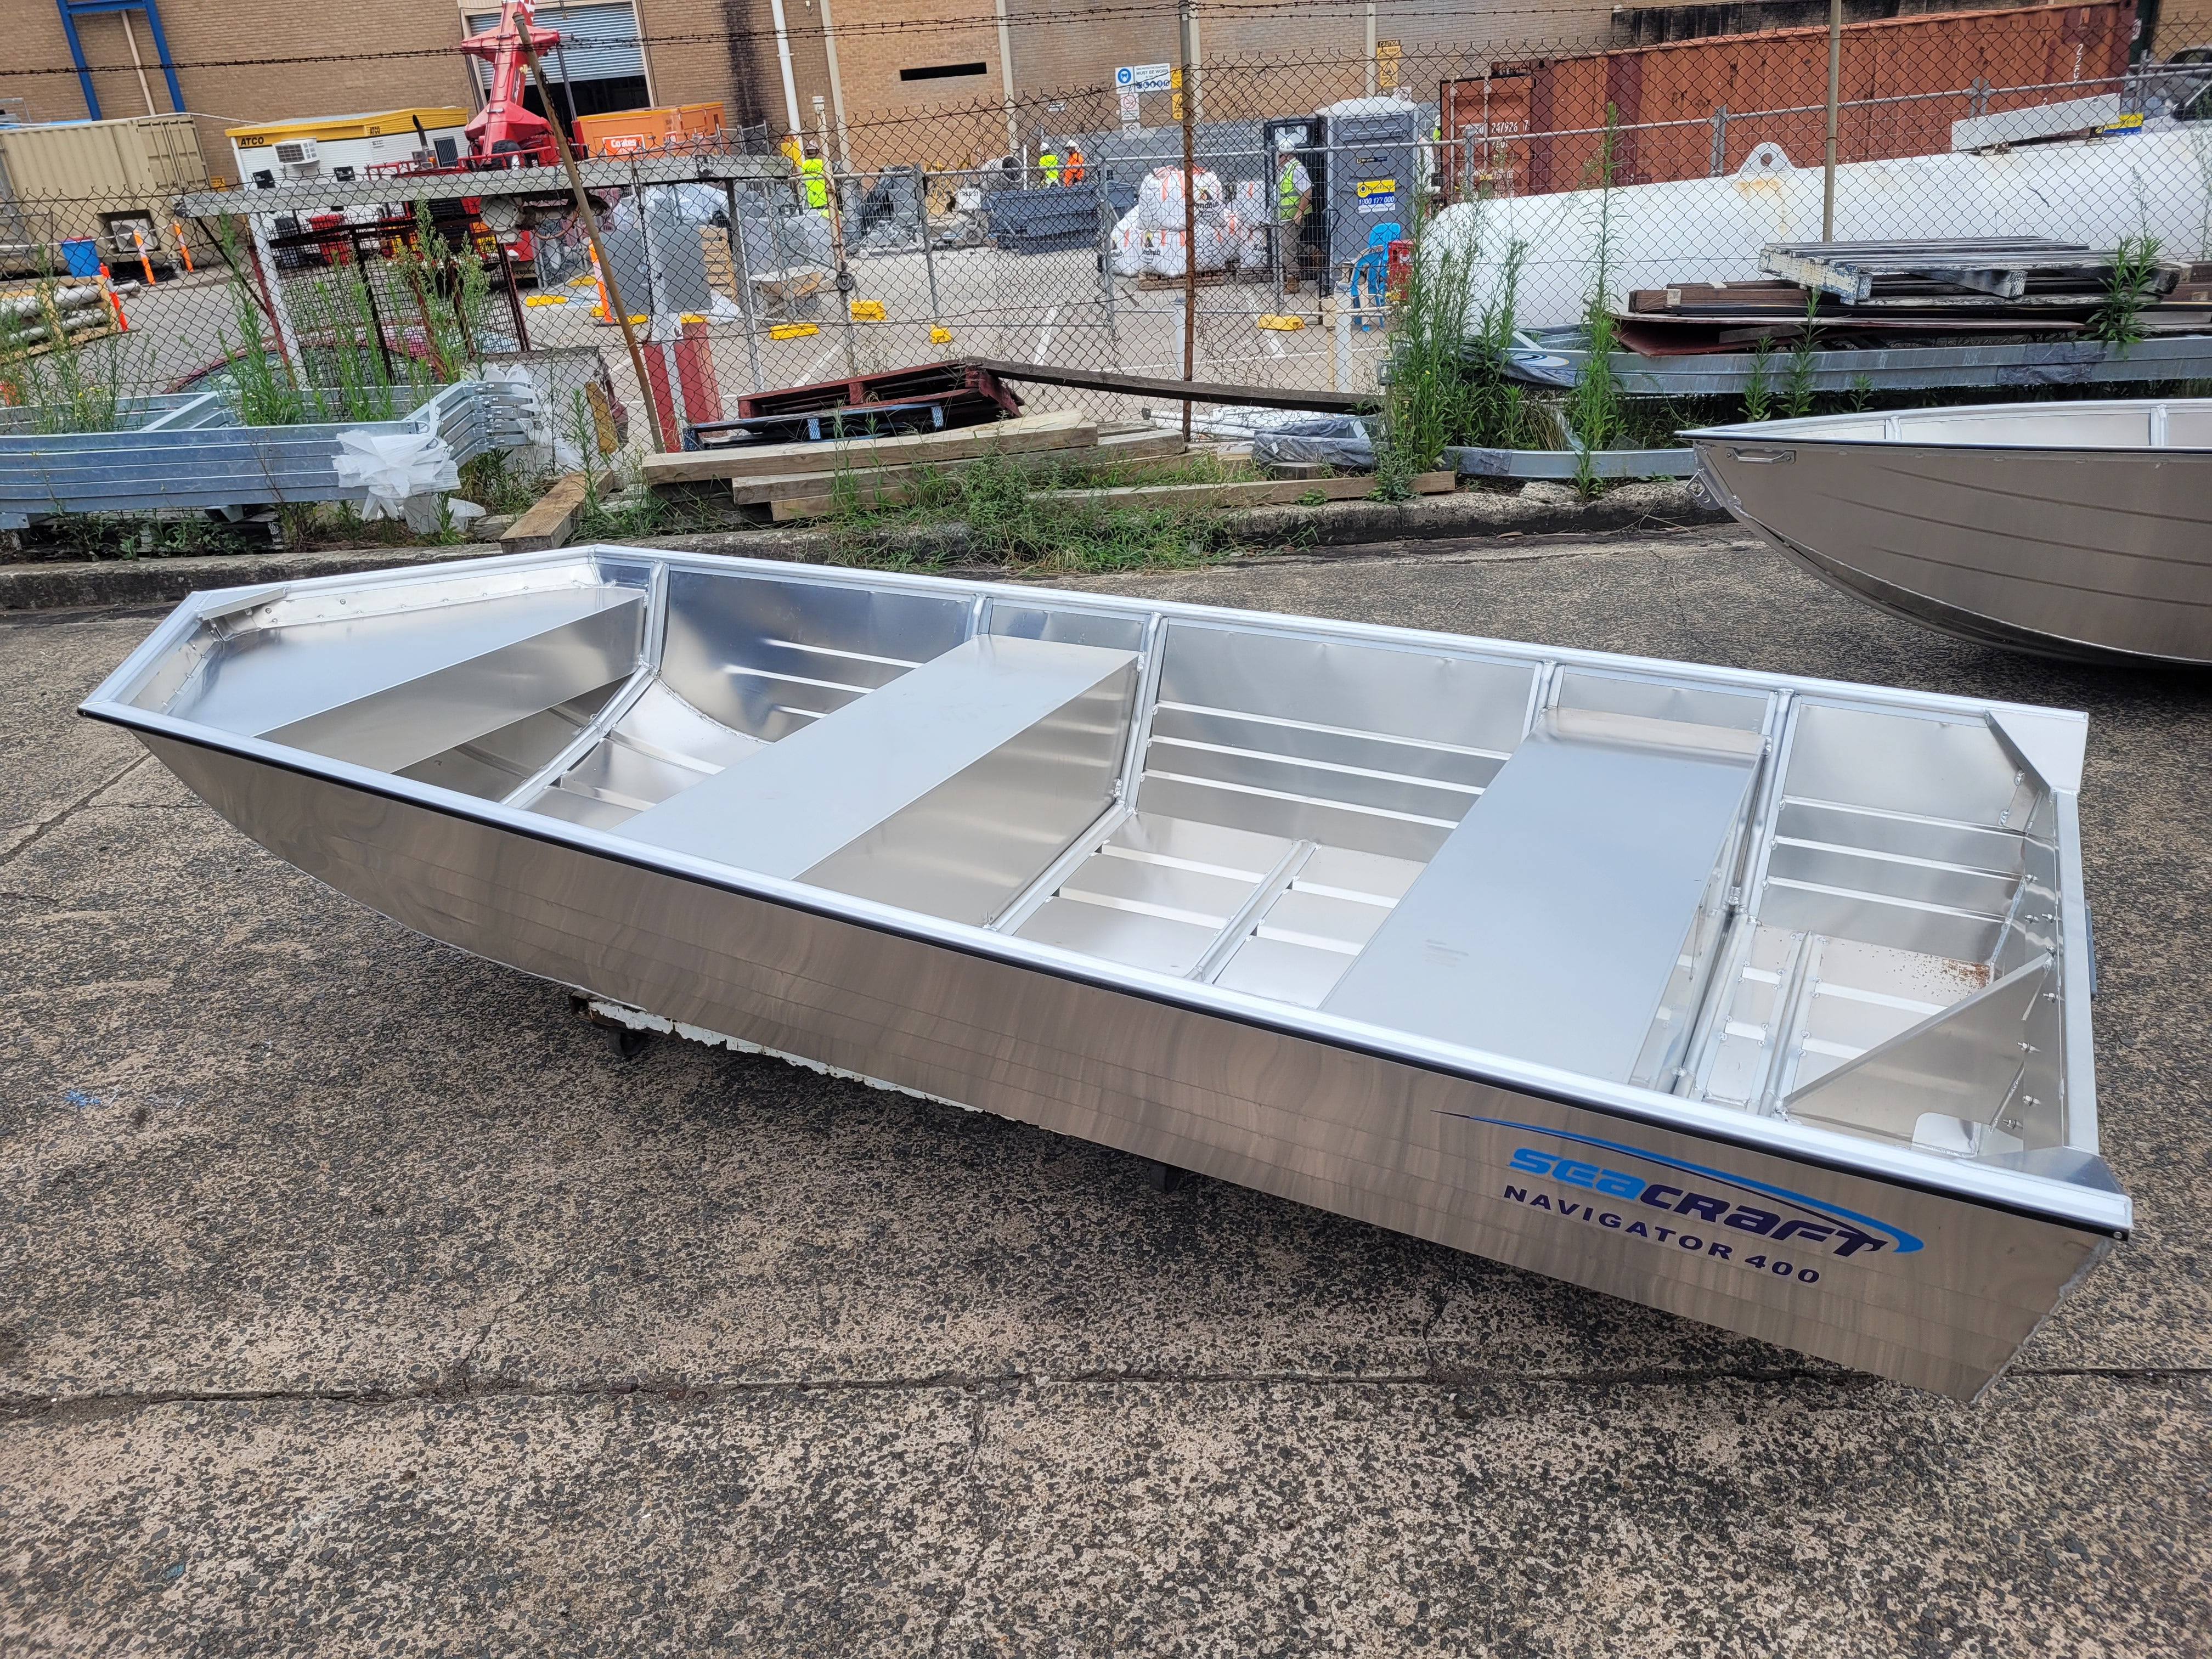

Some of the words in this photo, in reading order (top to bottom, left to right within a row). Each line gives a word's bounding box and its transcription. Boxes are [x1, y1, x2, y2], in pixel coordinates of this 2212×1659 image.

[1491, 121, 1518, 133] 247926
[241, 137, 264, 146] ATCO
[610, 138, 637, 148] Coates
[1503, 1185, 1734, 1260] NAVIGATOR
[1744, 1255, 1821, 1284] 400
